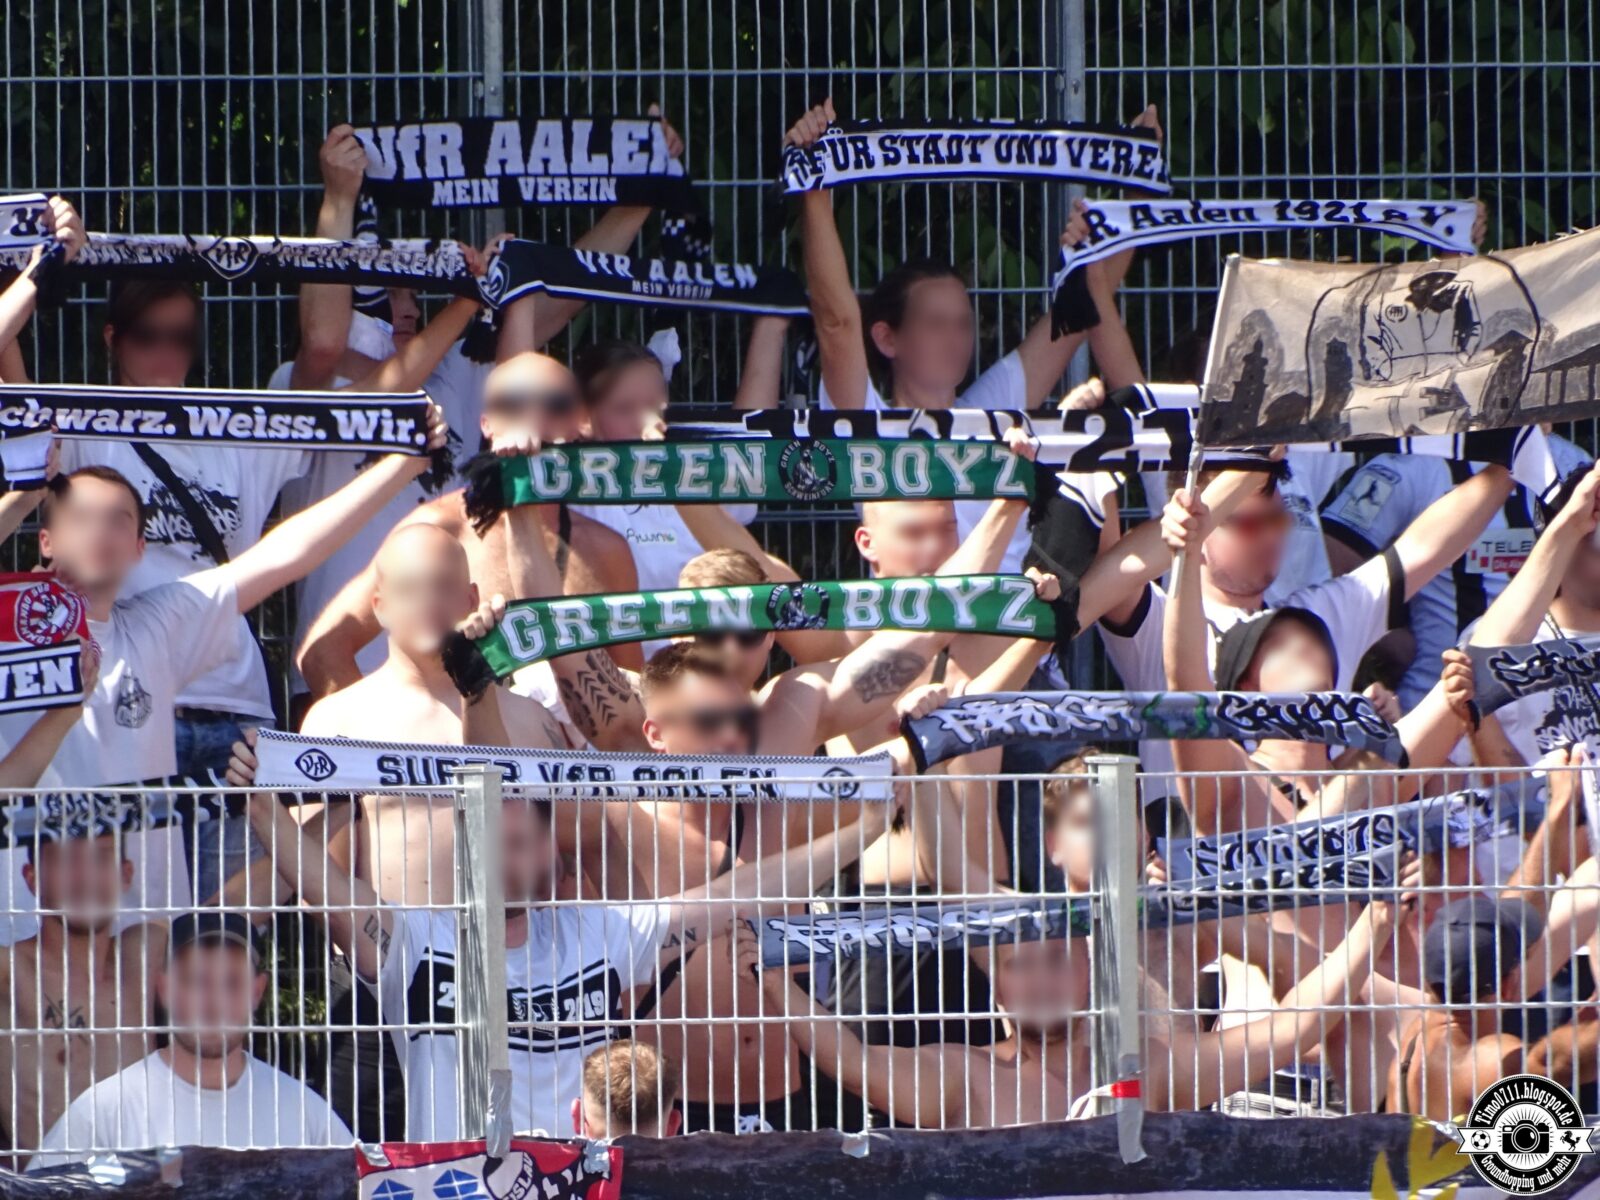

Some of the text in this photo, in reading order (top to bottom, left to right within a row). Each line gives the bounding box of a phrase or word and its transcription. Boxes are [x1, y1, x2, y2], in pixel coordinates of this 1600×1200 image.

[353, 122, 466, 181] VfR
[878, 133, 988, 167] STADT
[994, 132, 1058, 167] UND
[432, 176, 618, 206] MEIN VEREIN
[1083, 208, 1120, 245] R
[1130, 199, 1260, 230] Aalen
[1274, 199, 1368, 224] 1921
[631, 279, 714, 300] MEIN VEREIN
[649, 258, 758, 289] AALEN
[0, 398, 427, 446] chwarz. Weiss. Wir.
[527, 442, 1028, 498] GREEN BOYZ
[1481, 540, 1533, 553] TELE
[500, 577, 1036, 663] GREEN BOYZ
[376, 753, 522, 794] SUPR
